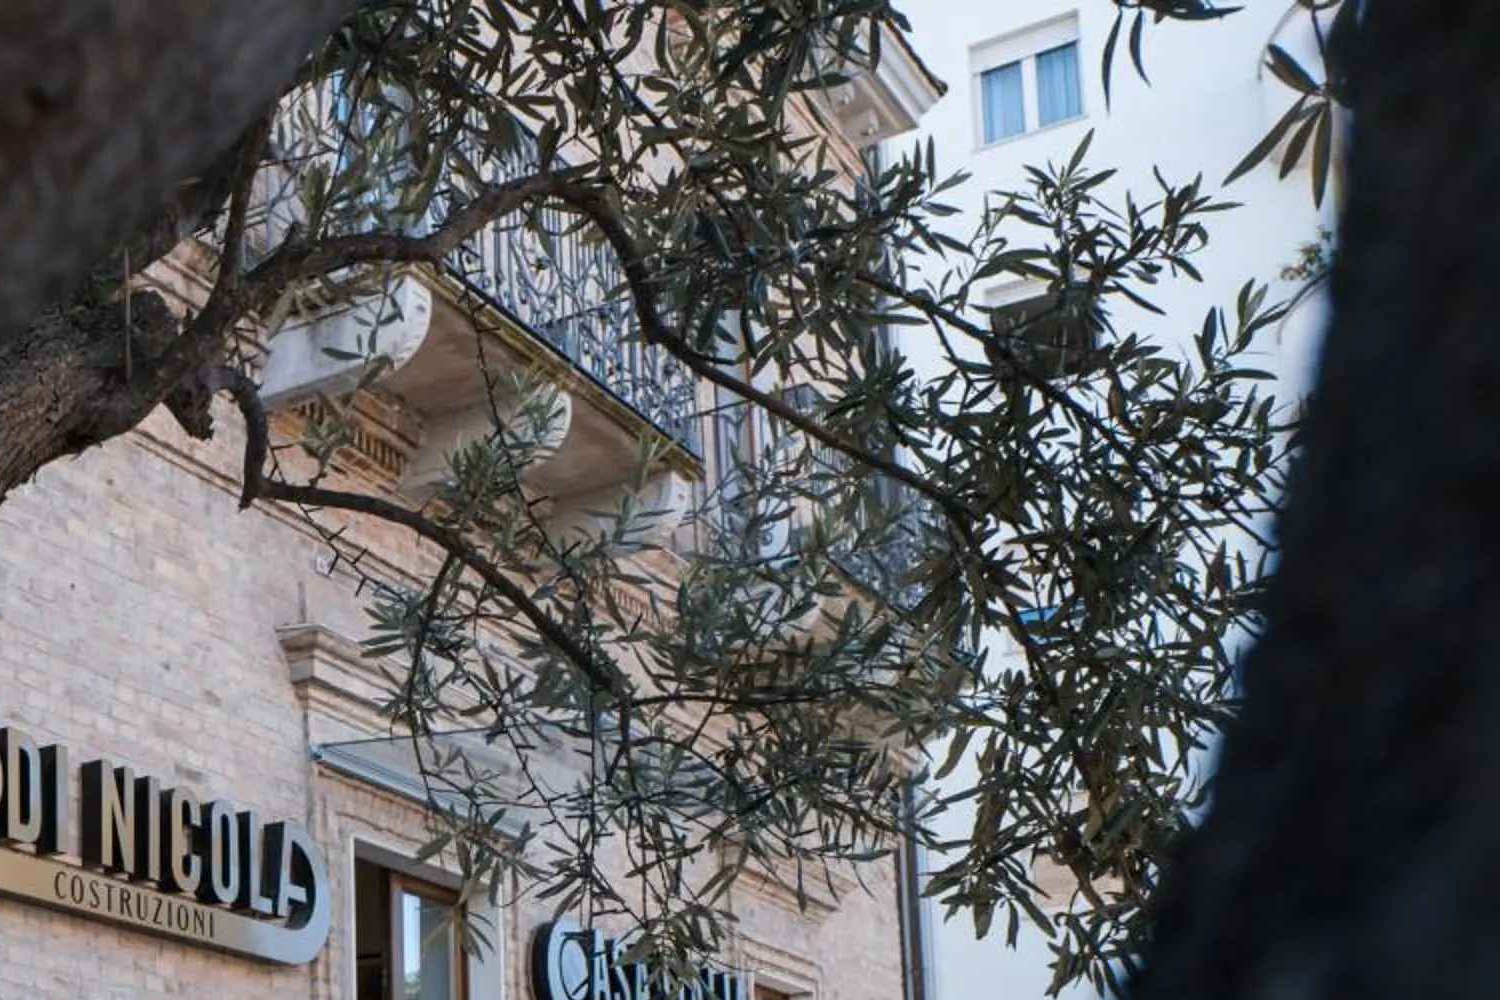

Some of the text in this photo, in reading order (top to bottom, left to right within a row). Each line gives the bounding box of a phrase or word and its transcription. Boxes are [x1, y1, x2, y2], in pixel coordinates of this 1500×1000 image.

[5, 726, 328, 930] DI NICOLA
[53, 869, 215, 939] COSTRUZIONI
